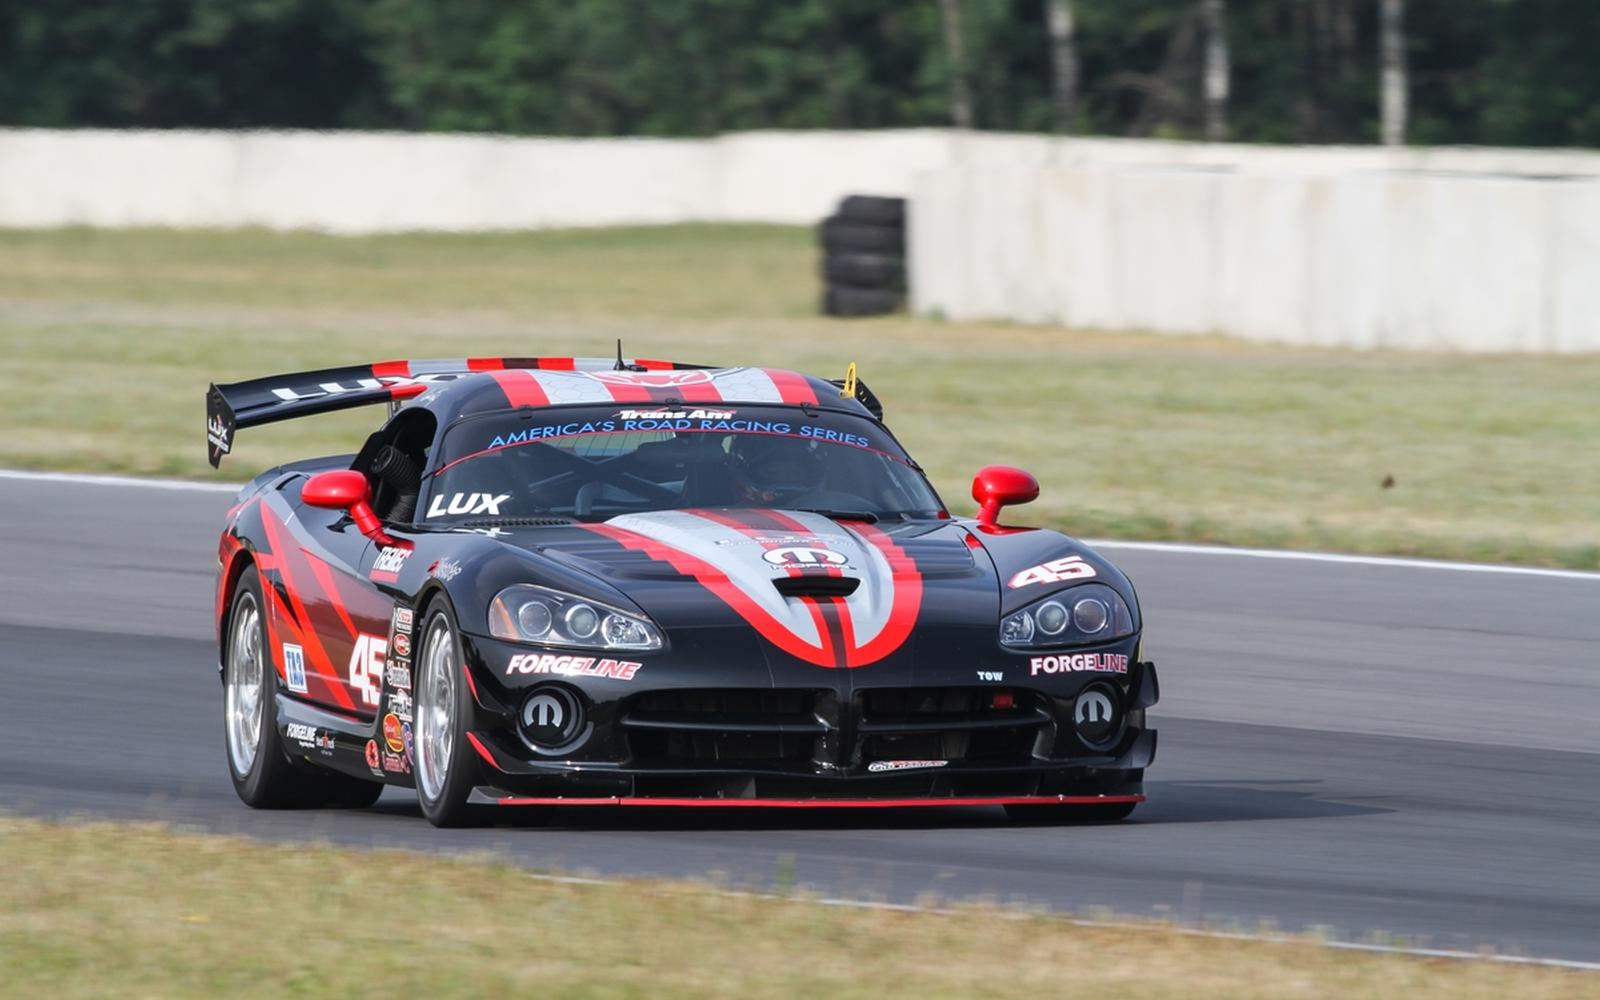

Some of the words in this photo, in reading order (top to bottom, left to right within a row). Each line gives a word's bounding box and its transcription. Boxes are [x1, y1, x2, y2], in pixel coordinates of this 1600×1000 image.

[619, 409, 687, 420] Trans
[687, 409, 733, 420] Am
[487, 420, 616, 450] AMERICA'S
[624, 419, 692, 431] ROAD
[700, 419, 791, 434] RACING
[799, 425, 869, 448] SERIES
[426, 492, 511, 519] LUX
[1008, 555, 1097, 590] 45
[349, 631, 388, 706] 45
[506, 653, 643, 681] FORGELINE
[977, 671, 1003, 682] TOW
[1030, 653, 1129, 677] FORGELINE
